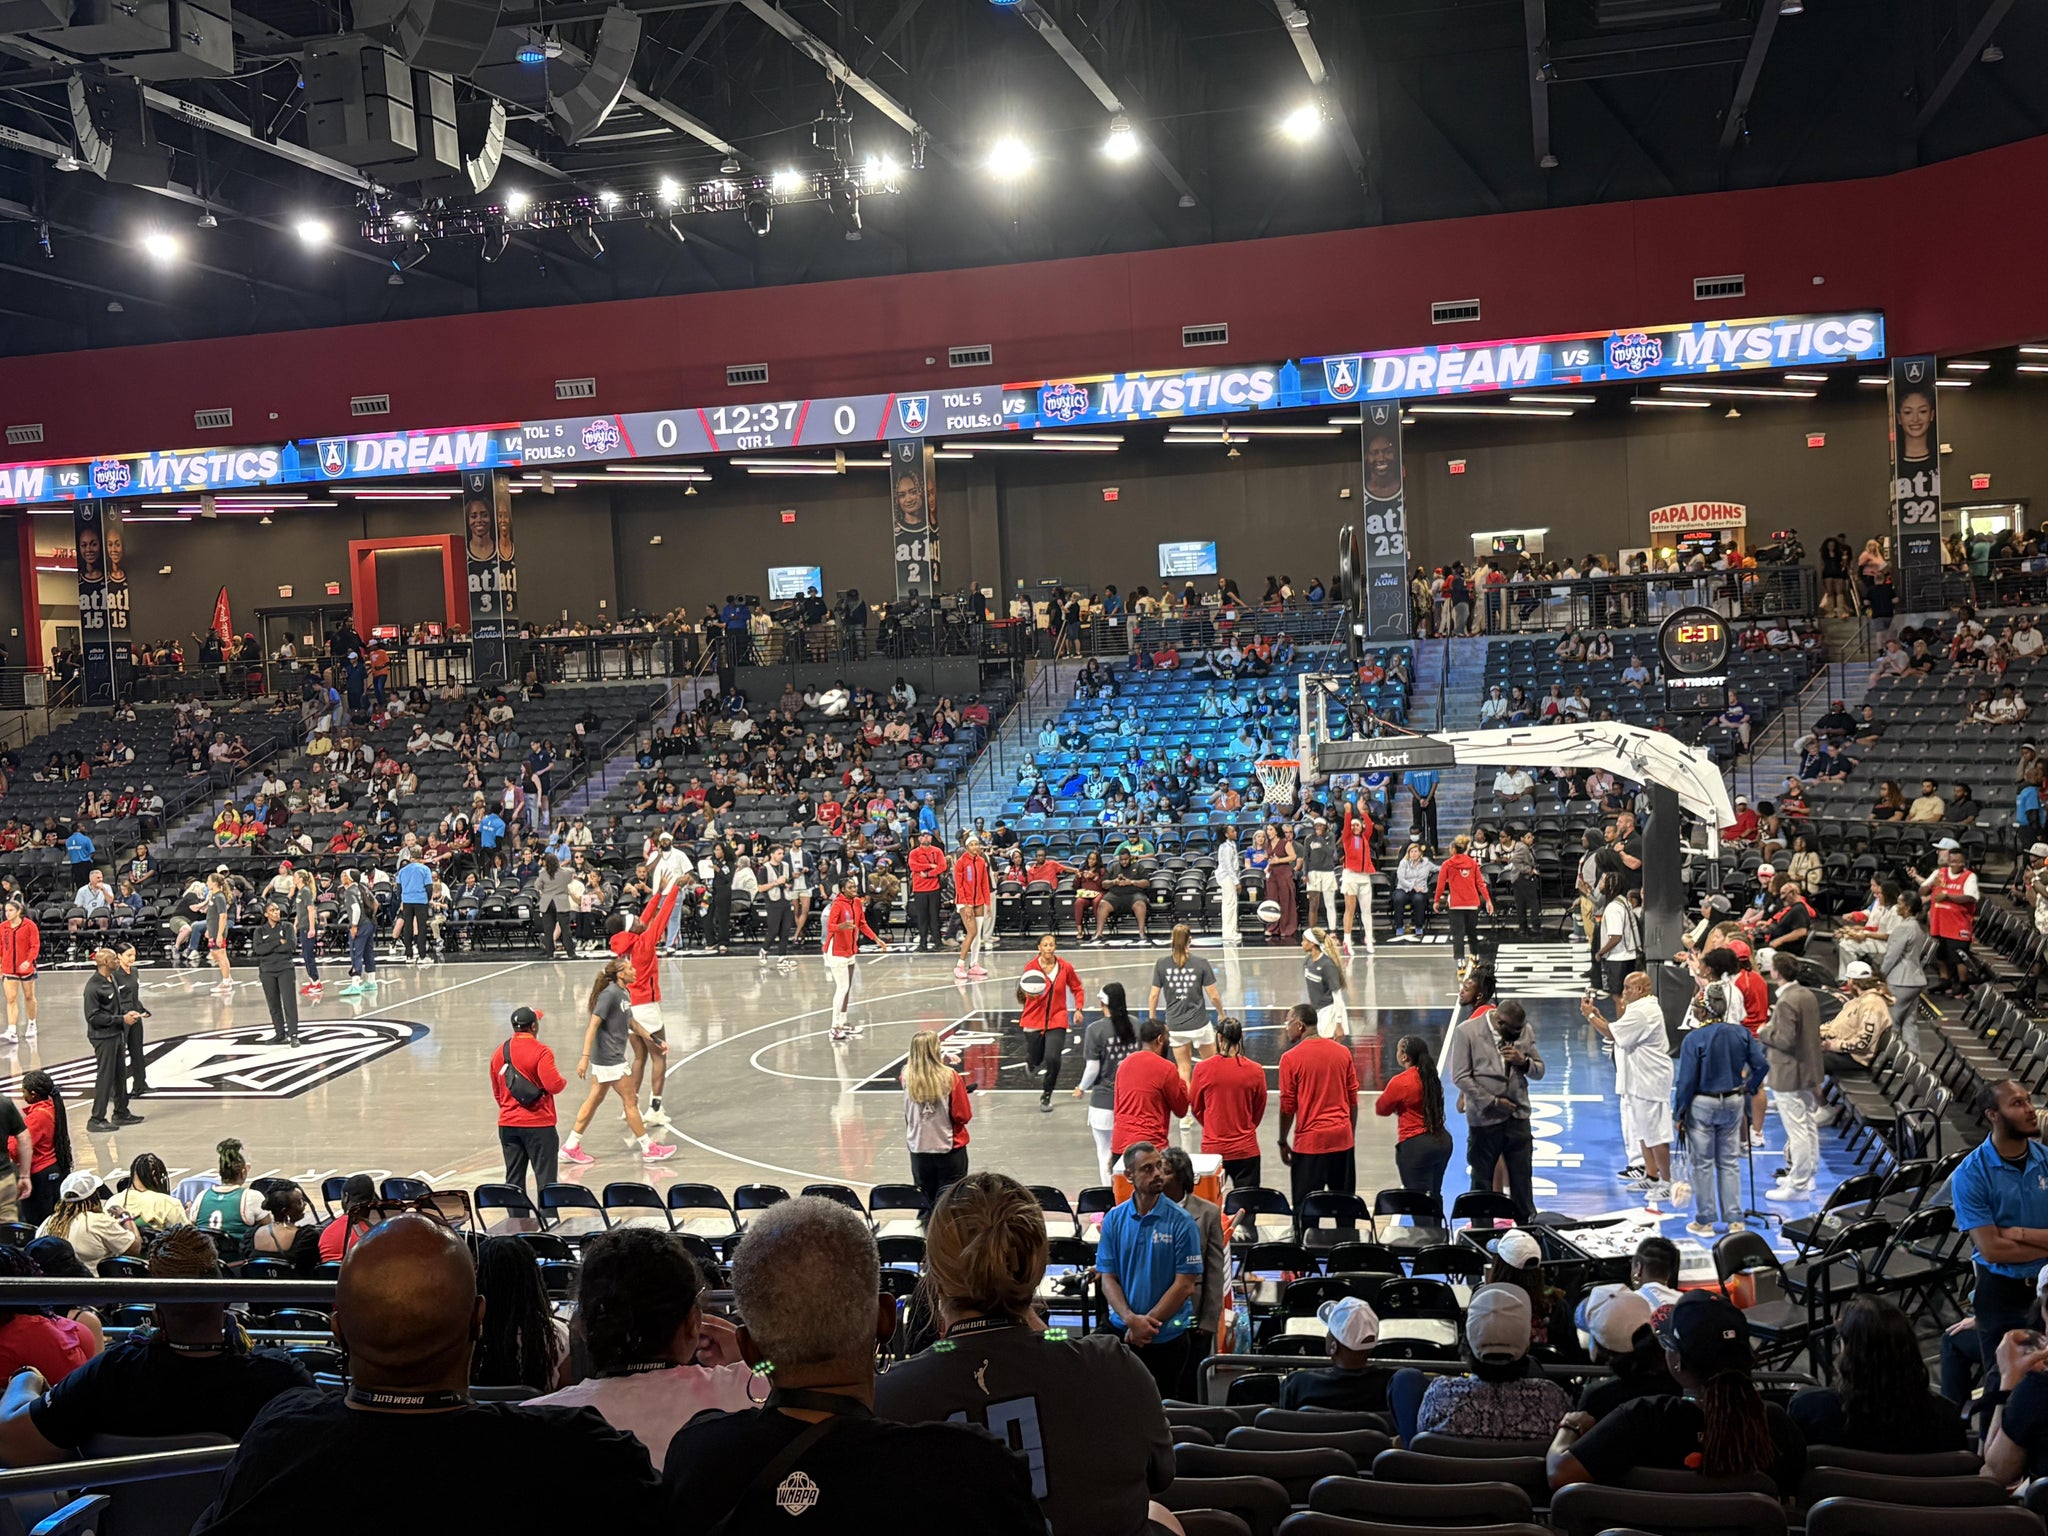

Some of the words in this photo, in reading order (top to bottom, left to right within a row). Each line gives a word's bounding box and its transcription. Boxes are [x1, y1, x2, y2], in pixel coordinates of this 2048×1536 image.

[1674, 319, 1874, 367] MYSTICS
[1367, 345, 1541, 393] DREAM
[942, 395, 970, 408] TOL:
[973, 393, 982, 405] 5
[1098, 371, 1275, 415] MYSTICS
[713, 403, 798, 435] 12:37
[834, 405, 856, 435] 0
[947, 415, 991, 429] FOULS:
[993, 414, 1002, 426] 0
[524, 427, 549, 439] TOL:
[555, 425, 563, 437] 5
[657, 419, 677, 448] 0
[737, 436, 762, 450] QTR
[764, 435, 774, 447] 1
[352, 432, 488, 472] DREAM
[525, 447, 565, 460] FOULS:
[567, 446, 576, 457] 0
[138, 451, 279, 488] MYSTICS
[1896, 469, 1940, 499] atl
[1651, 505, 1690, 524] PAPA
[1691, 504, 1742, 521] JOHNS
[1903, 500, 1936, 524] 32
[1375, 536, 1404, 556] 23
[908, 563, 921, 582] 2
[480, 594, 492, 613] 3
[506, 594, 513, 612] 3
[111, 611, 127, 628] 15
[1677, 625, 1718, 643] 12:37
[1684, 677, 1726, 687] TISSOT
[1365, 752, 1409, 768] Albert
[123, 1266, 133, 1275] 12
[267, 1268, 278, 1278] 10
[887, 1277, 894, 1286] 2
[1317, 1287, 1324, 1296] 4
[1412, 1286, 1419, 1296] 3
[1298, 1346, 1306, 1356] 4
[1405, 1348, 1412, 1358] 3
[372, 1393, 393, 1403] ELITE
[393, 1396, 425, 1405] DREAM
[778, 1488, 818, 1505] WNBPA
